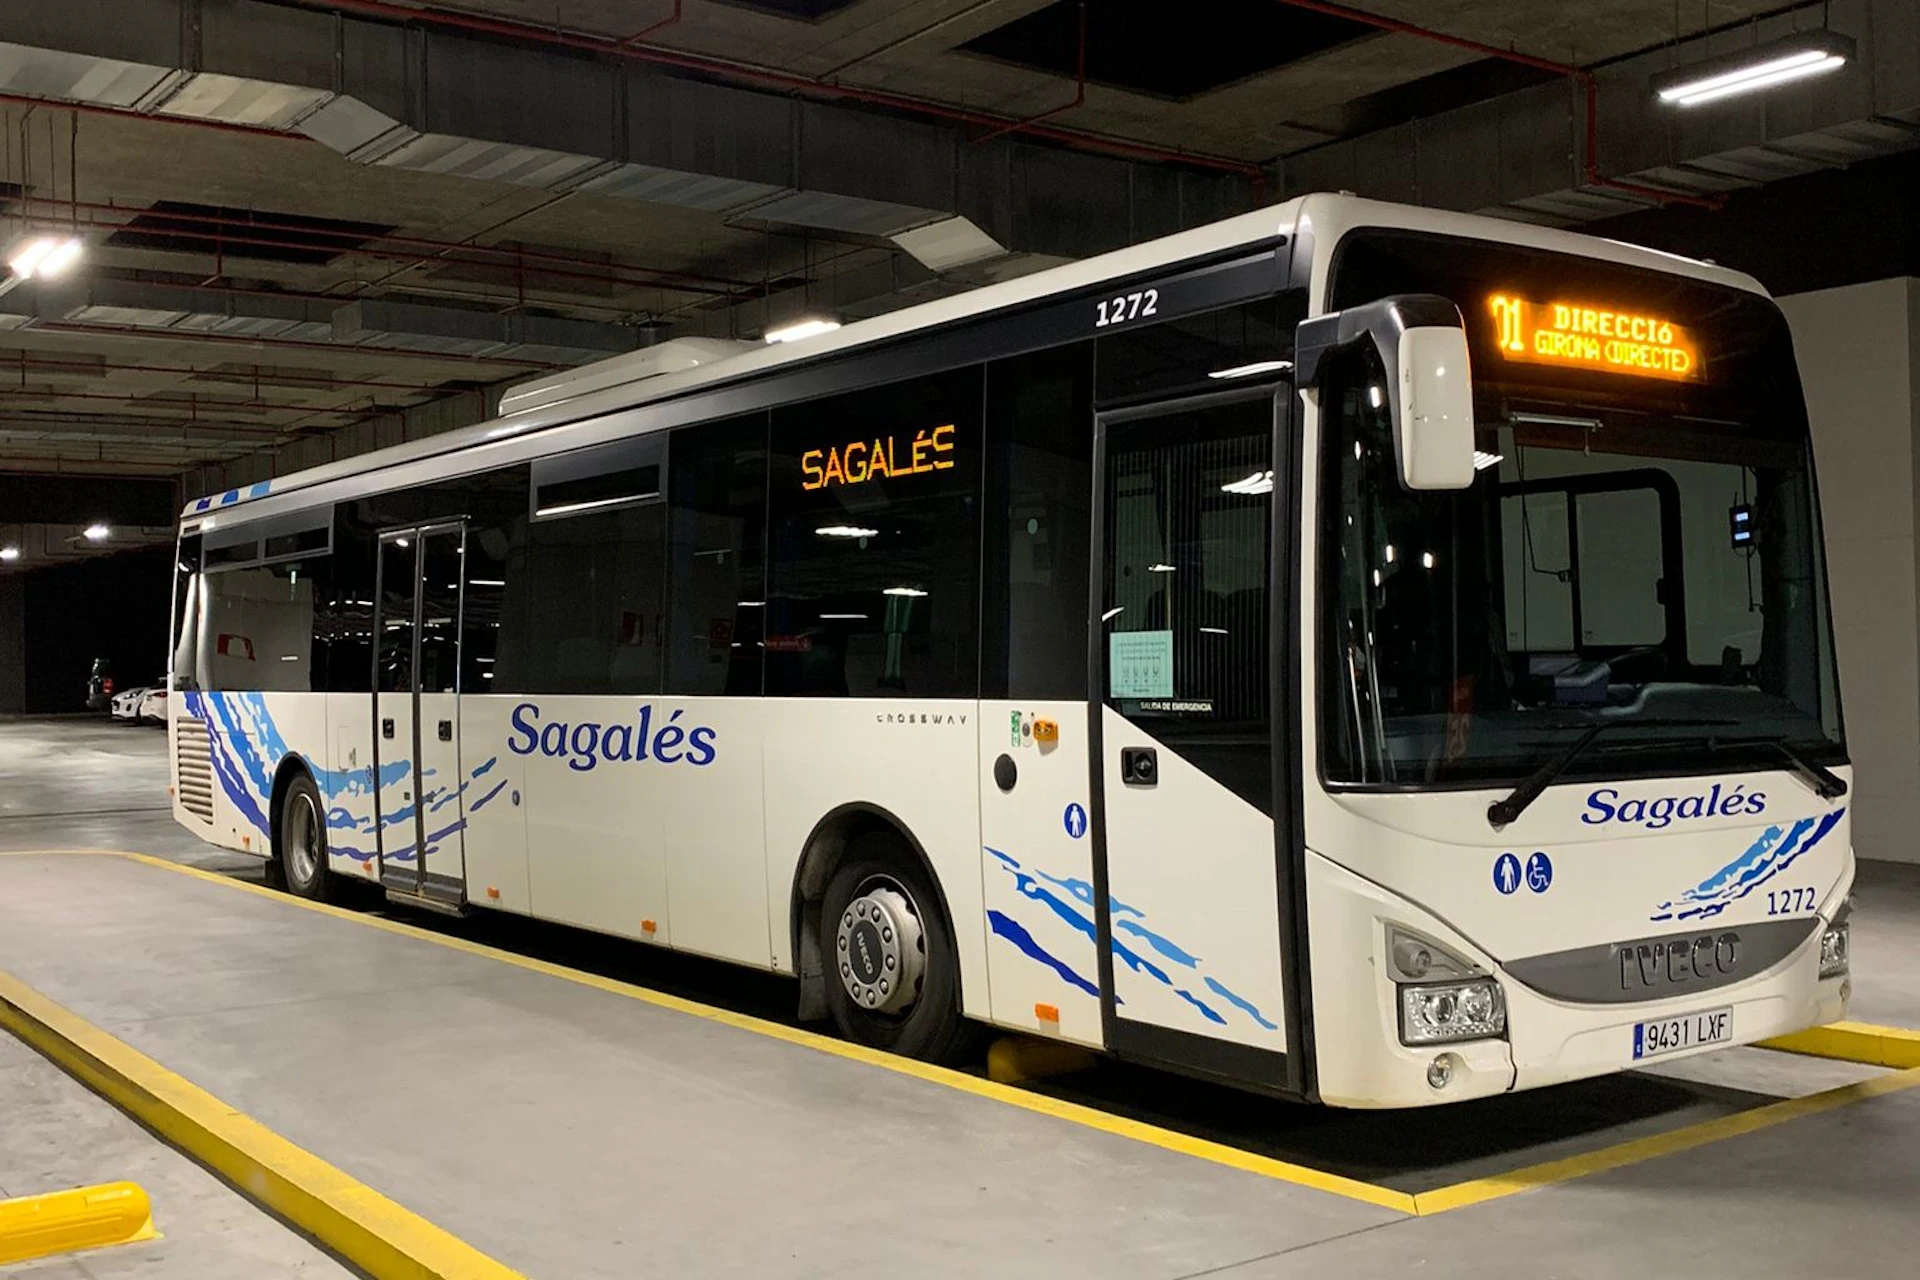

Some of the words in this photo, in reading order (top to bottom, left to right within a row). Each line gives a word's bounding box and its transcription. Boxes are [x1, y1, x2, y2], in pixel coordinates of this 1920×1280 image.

[1095, 288, 1159, 327] 1272
[1534, 329, 1600, 361] GIRONA
[802, 424, 955, 491] SAGALÉS
[508, 703, 716, 771] Sagalés
[1581, 784, 1767, 829] Sagalés
[1766, 887, 1817, 916] 1272
[856, 931, 874, 975] IVECO
[1619, 932, 1742, 991] IVECO
[1647, 1017, 1690, 1051] 9431
[1697, 1013, 1728, 1043] LXF
